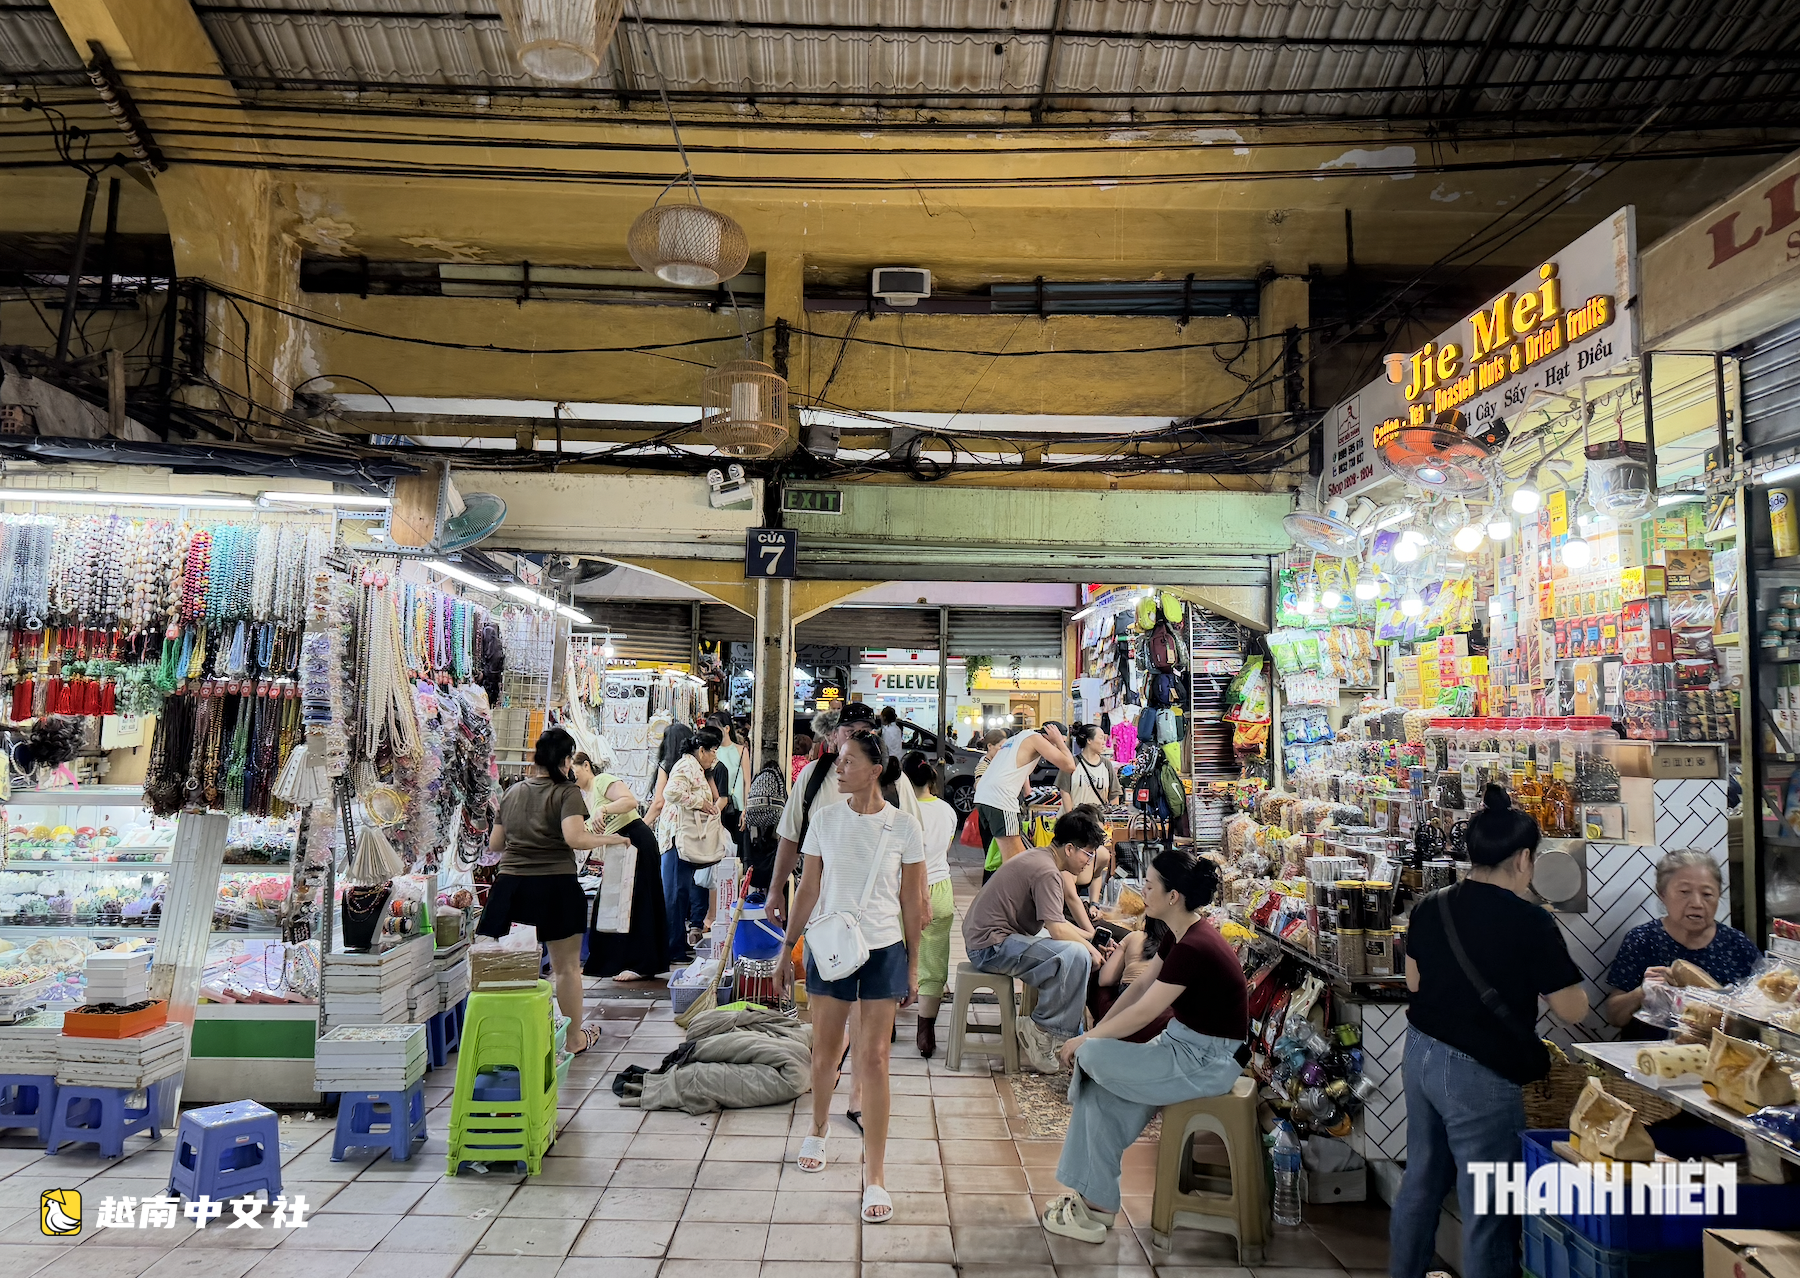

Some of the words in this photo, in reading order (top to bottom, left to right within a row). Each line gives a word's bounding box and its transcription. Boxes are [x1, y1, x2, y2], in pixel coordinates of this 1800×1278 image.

[1404, 342, 1458, 401] Jie
[1468, 263, 1559, 363] Mei
[1408, 403, 1425, 427] Tea
[1434, 368, 1476, 415] Roasted
[1478, 355, 1505, 391] Nuts
[1509, 343, 1520, 373] &
[1525, 318, 1562, 366] Dried
[1566, 296, 1606, 342] fruits
[1475, 401, 1497, 421] Cây
[1504, 382, 1527, 408] Sấy
[1545, 361, 1570, 387] Hạt
[1577, 338, 1613, 371] Điều
[788, 491, 838, 511] EXIT
[1328, 481, 1344, 497] Shop
[757, 530, 786, 544] CỬA
[759, 545, 786, 575] 7
